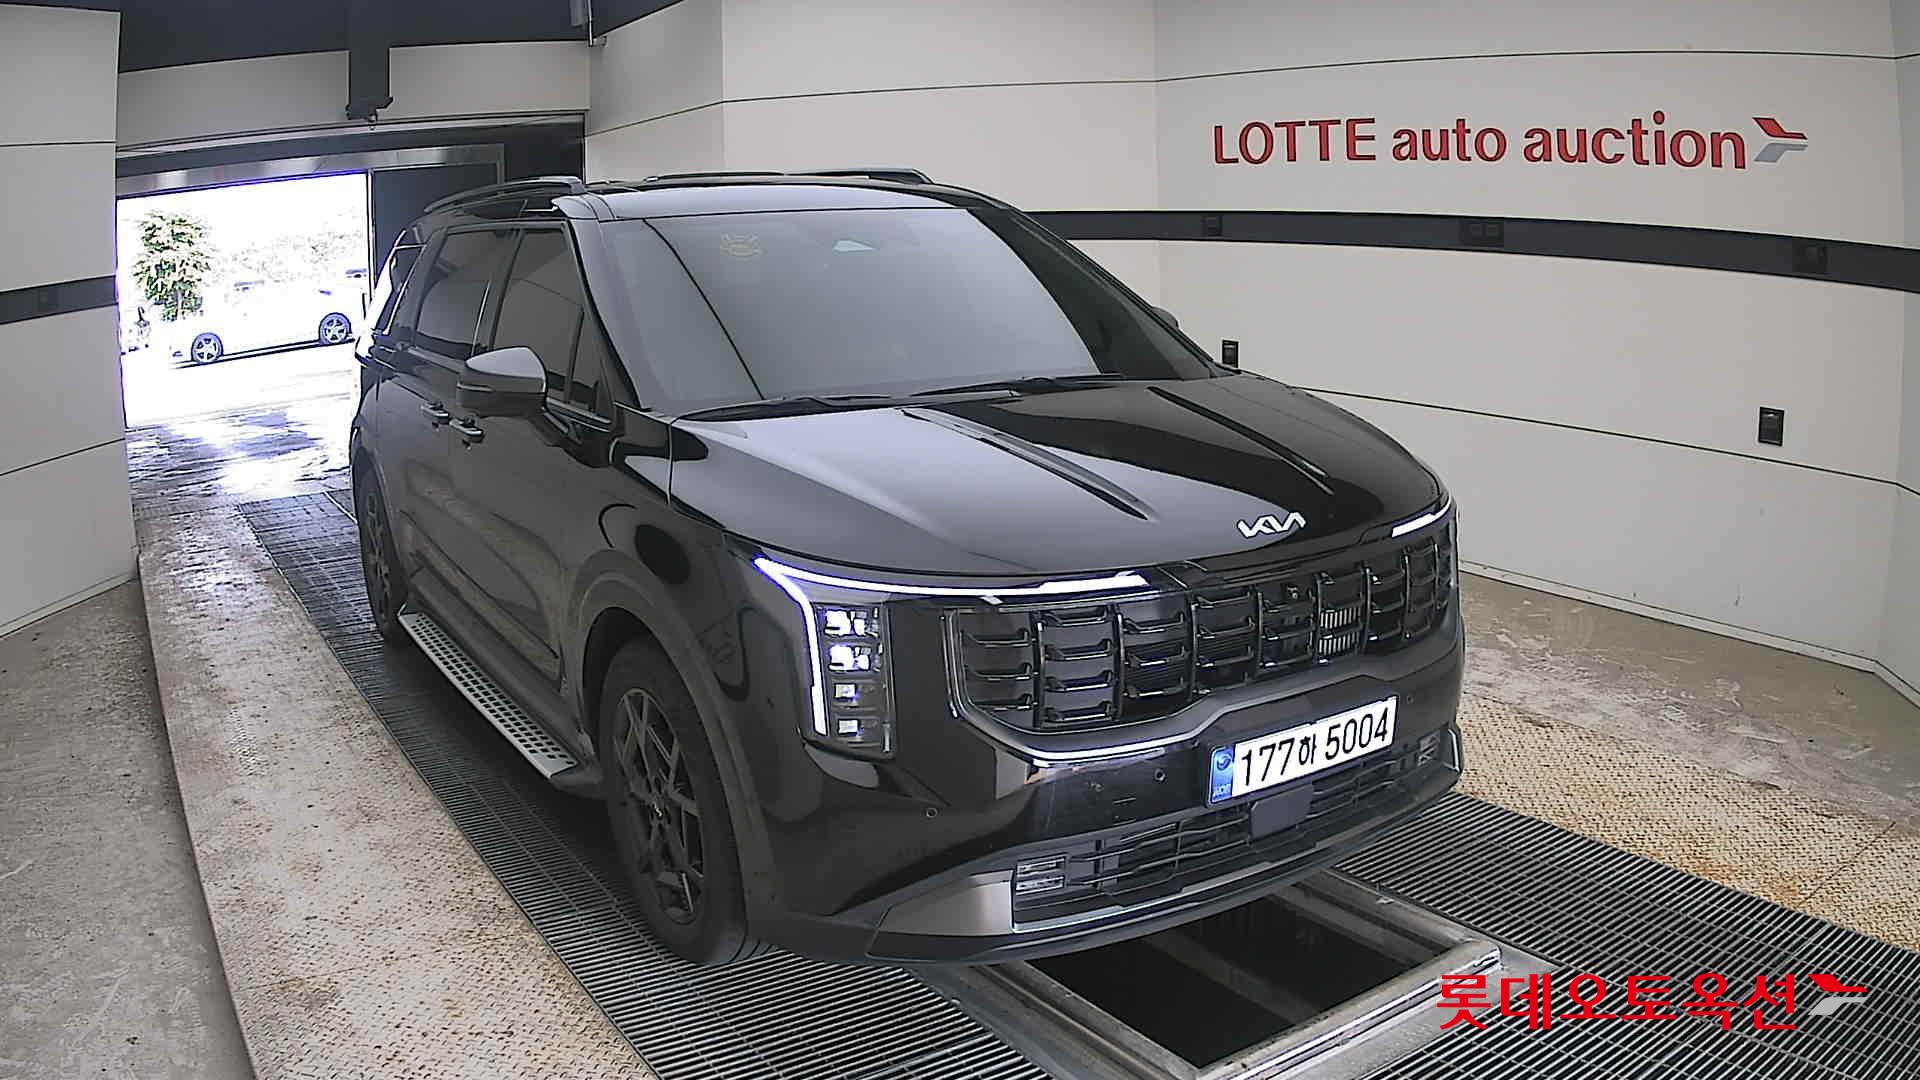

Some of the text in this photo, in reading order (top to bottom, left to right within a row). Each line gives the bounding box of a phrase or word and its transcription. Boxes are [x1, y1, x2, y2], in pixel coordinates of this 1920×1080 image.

[1213, 110, 1747, 169] LOTTE auto auction
[1241, 707, 1389, 786] 177하 5004
